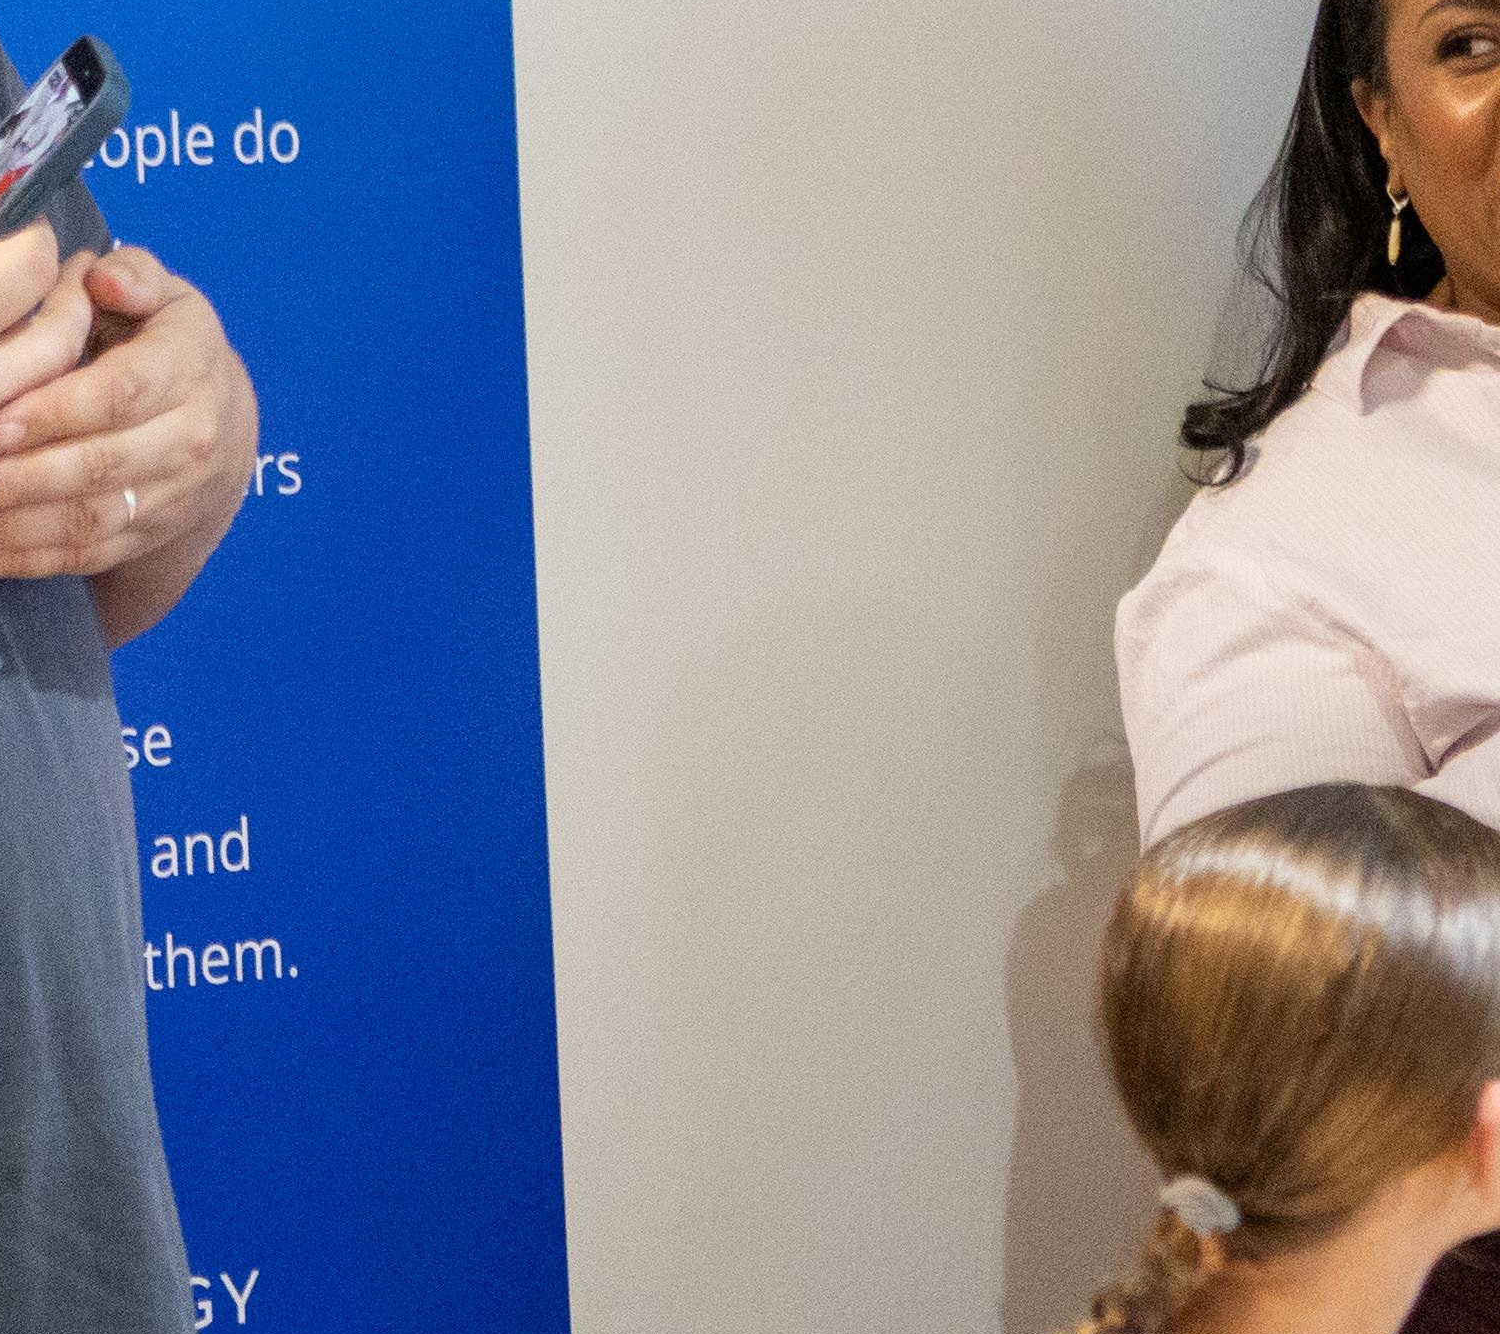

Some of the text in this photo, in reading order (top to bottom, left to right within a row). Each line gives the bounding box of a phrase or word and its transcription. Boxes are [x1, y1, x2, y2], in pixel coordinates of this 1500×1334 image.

[83, 107, 300, 184] ople do
[243, 452, 302, 496] rs
[151, 813, 251, 880] and
[143, 931, 299, 992] them.
